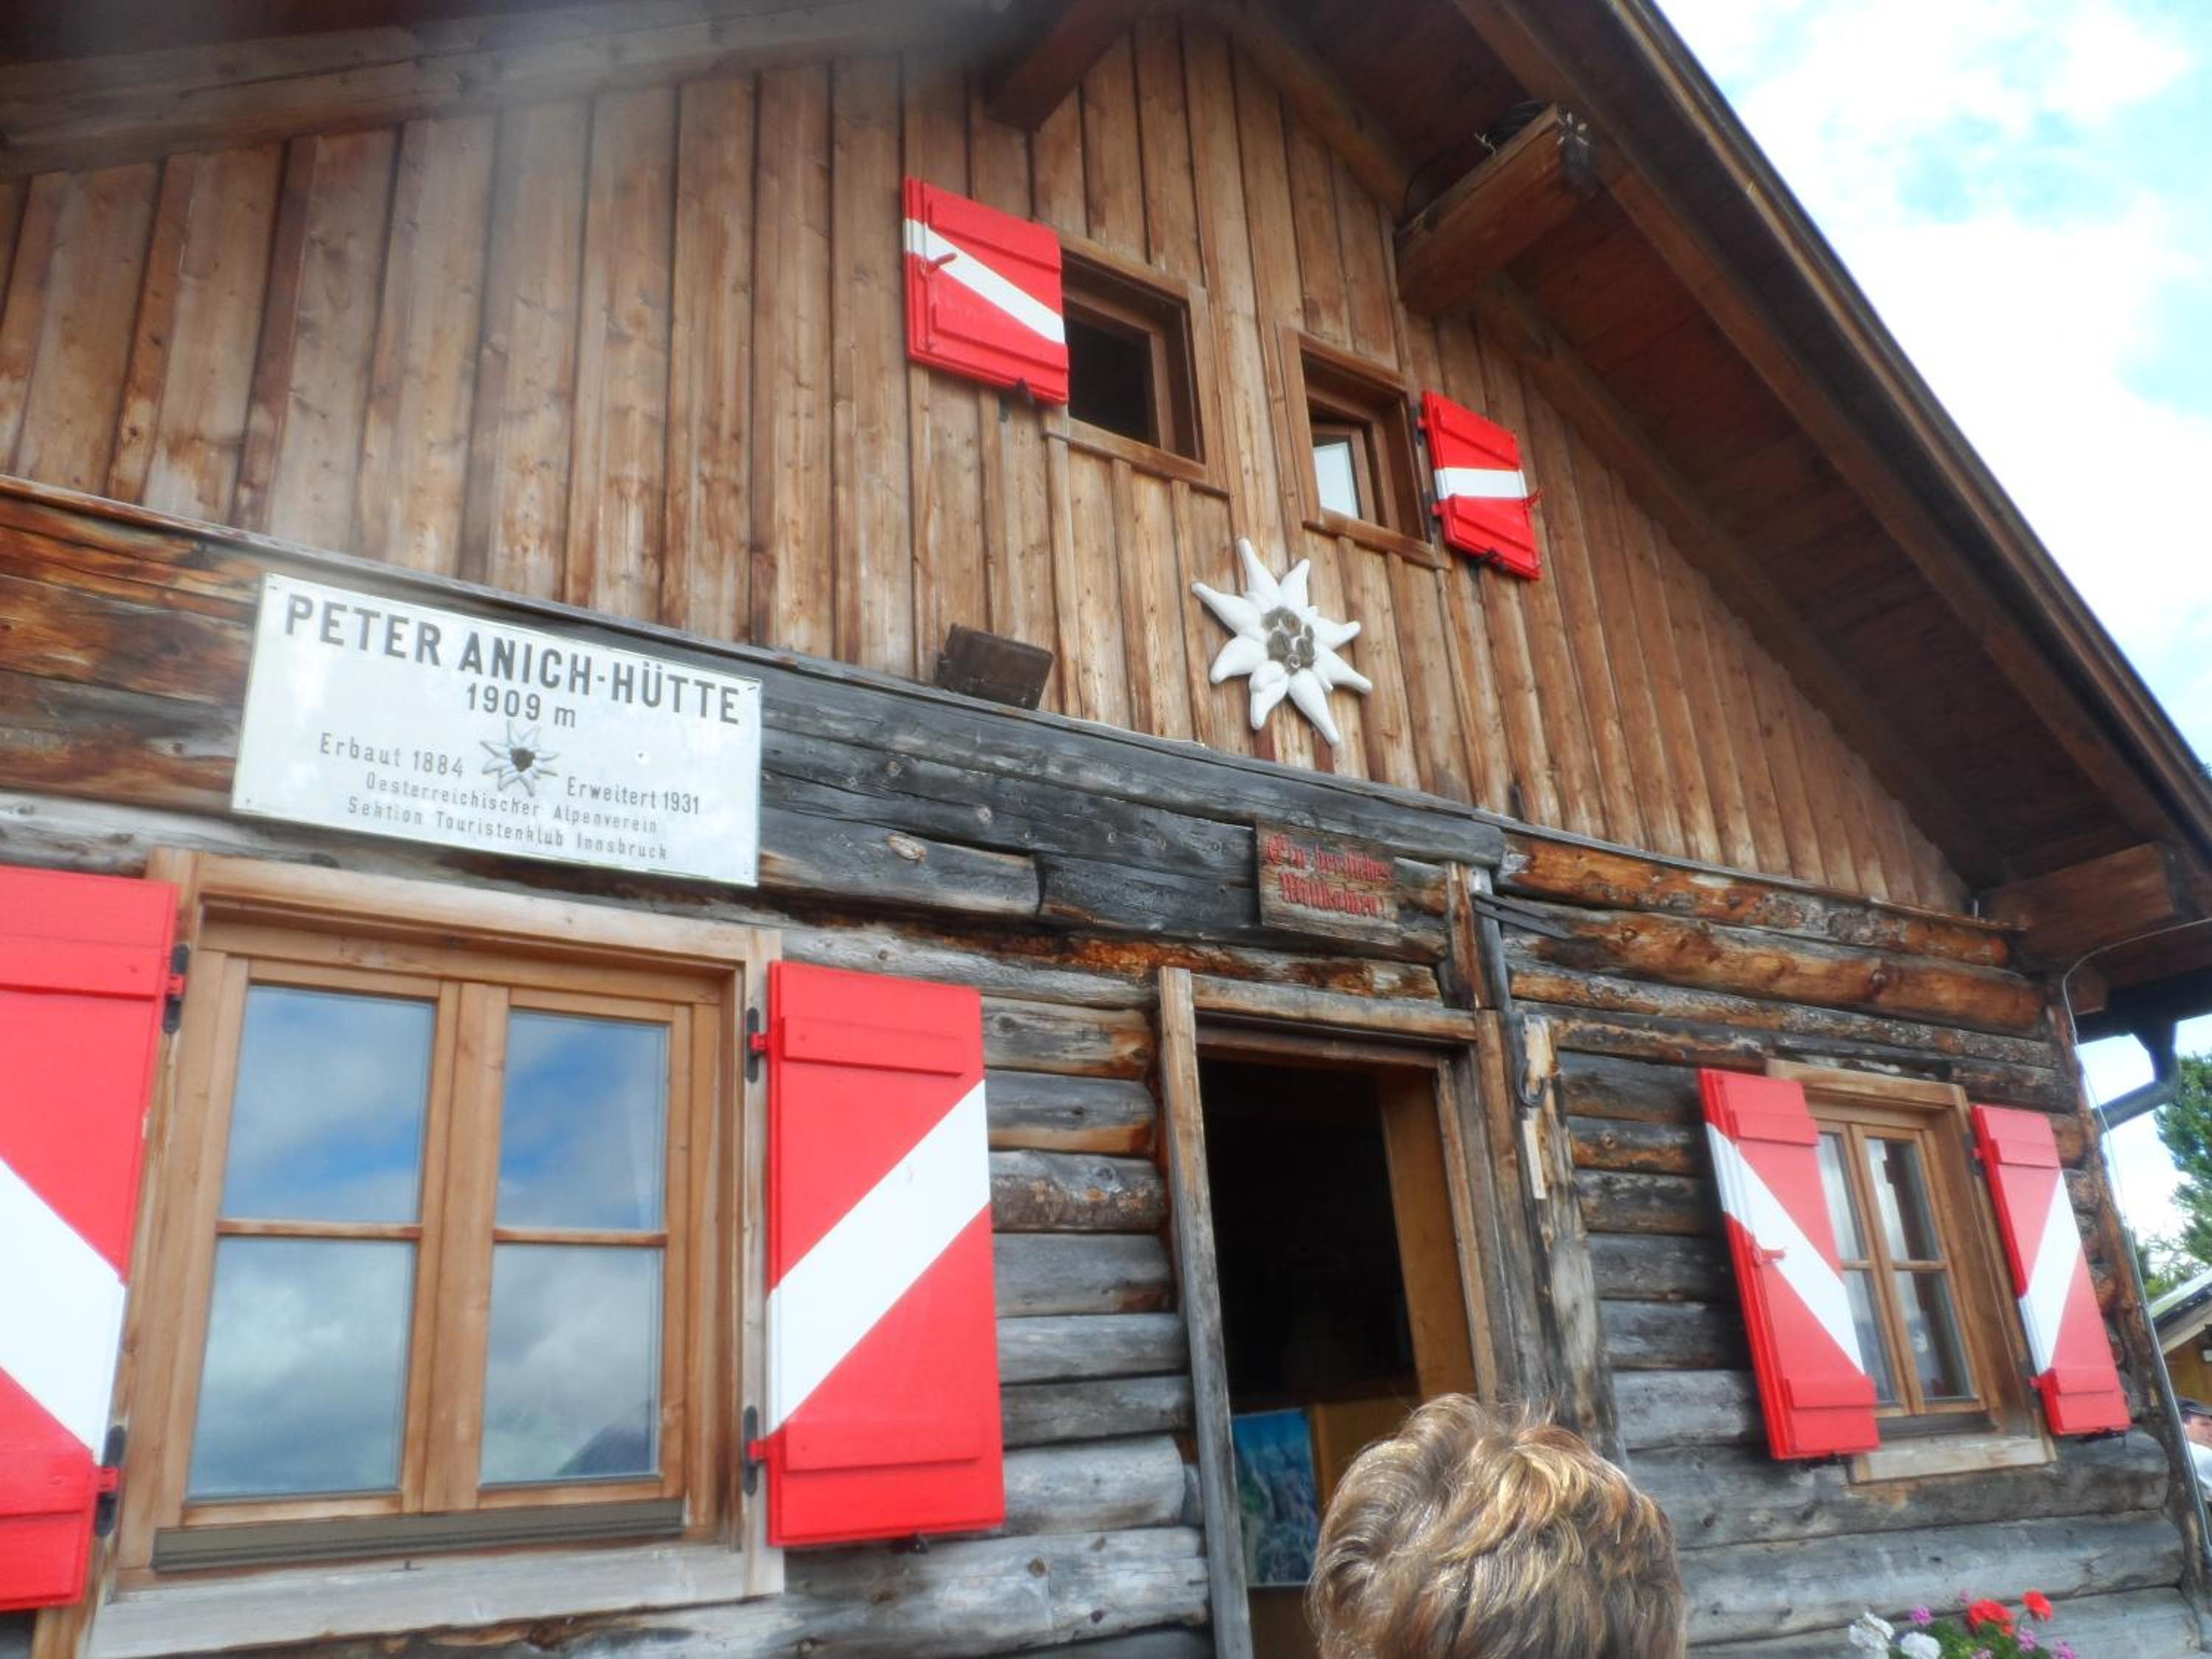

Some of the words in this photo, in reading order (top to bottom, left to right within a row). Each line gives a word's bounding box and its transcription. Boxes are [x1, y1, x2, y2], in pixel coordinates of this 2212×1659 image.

[285, 594, 441, 666] PETER
[457, 631, 740, 725] ANICH-HÜTTE
[466, 682, 541, 721] 1909
[554, 706, 577, 728] m
[319, 732, 402, 768] Erbaut
[413, 750, 464, 777] 1884
[366, 771, 540, 815] Oesterreichischer
[554, 804, 658, 834] Alpenverein
[567, 776, 656, 809] Erweitert
[664, 790, 700, 815] 1931
[347, 796, 423, 826] Sektion
[437, 810, 564, 847] Touristenklub
[577, 831, 667, 860] Innsbruck
